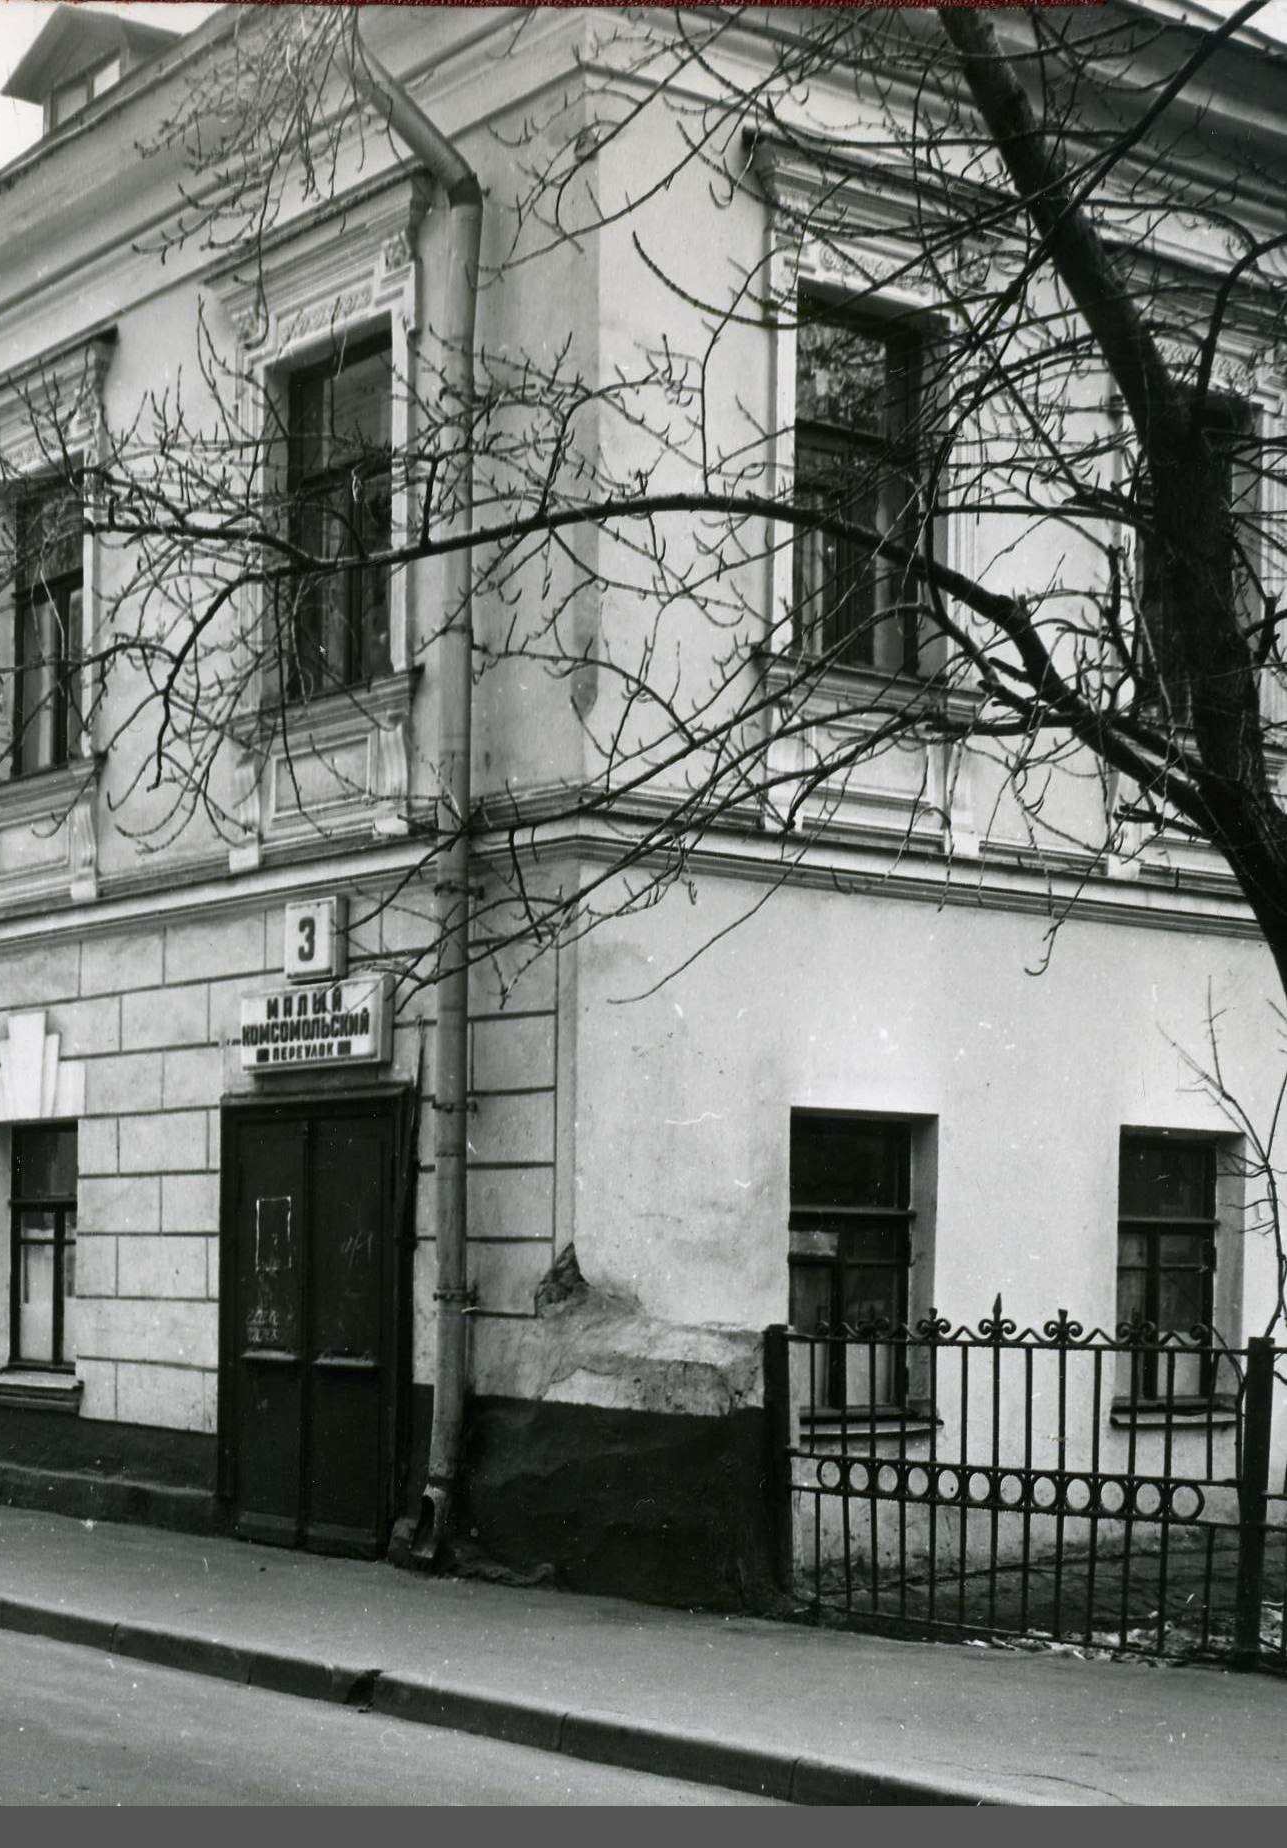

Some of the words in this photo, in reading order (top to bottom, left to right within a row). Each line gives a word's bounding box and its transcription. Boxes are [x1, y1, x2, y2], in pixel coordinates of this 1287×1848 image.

[297, 917, 316, 962] 3
[266, 987, 342, 1020] МАЛЫЙ
[242, 1007, 369, 1046] КОМСОМОЛЬСКИЙ
[273, 1041, 334, 1061] ПЕРЕУЛОК
